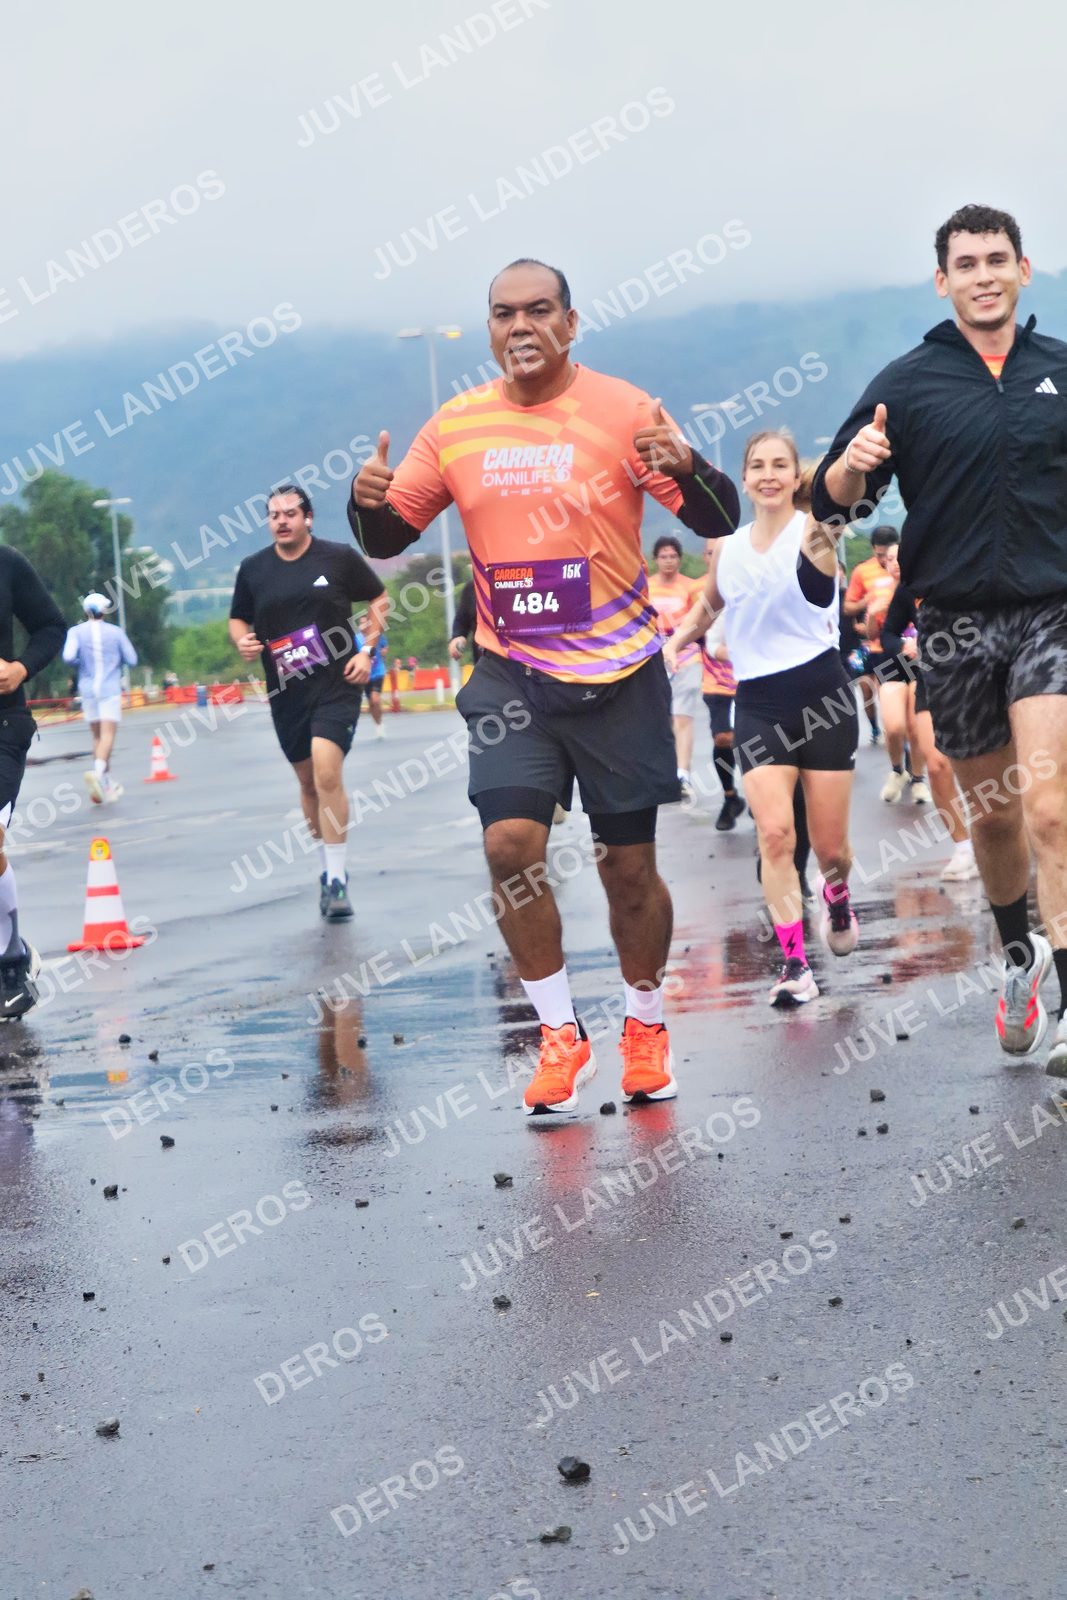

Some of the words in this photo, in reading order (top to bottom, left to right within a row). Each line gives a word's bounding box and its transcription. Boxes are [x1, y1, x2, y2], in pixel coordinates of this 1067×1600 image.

[483, 444, 574, 470] CARRERA
[494, 567, 533, 581] CARRERA
[512, 591, 559, 615] 484
